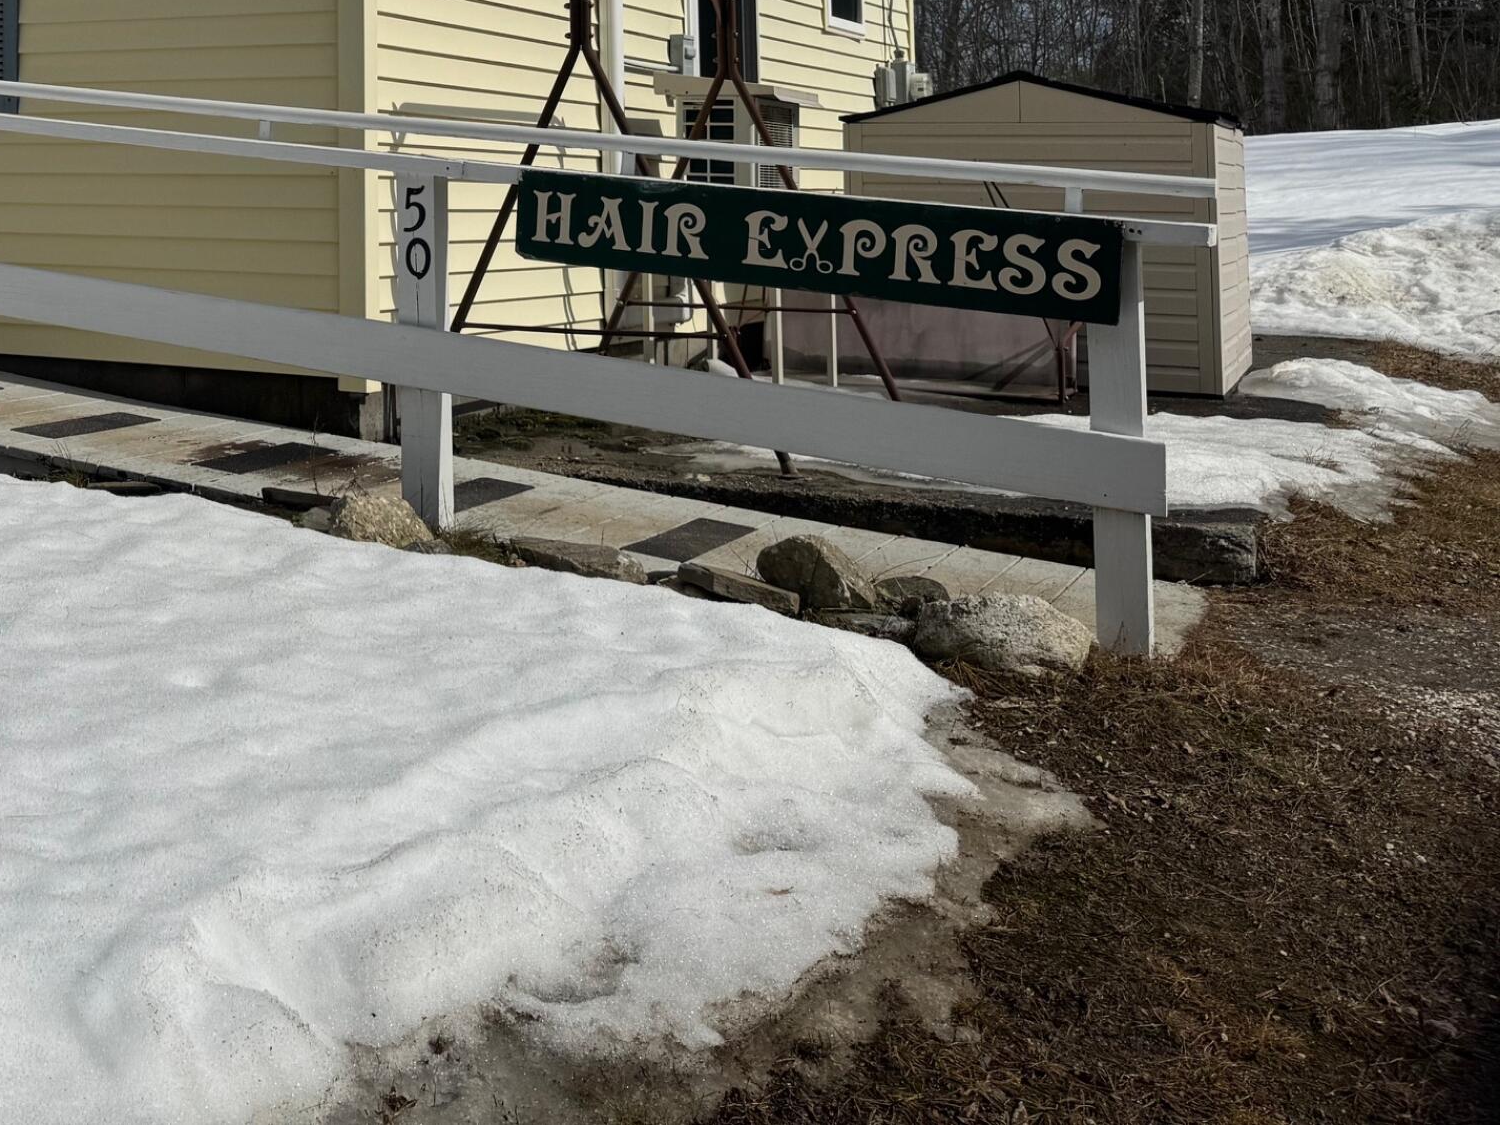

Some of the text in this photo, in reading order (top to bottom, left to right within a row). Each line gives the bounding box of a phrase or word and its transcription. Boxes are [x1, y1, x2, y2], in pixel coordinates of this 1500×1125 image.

[403, 185, 431, 279] 50
[531, 190, 1101, 301] HAIR EXPRESS
